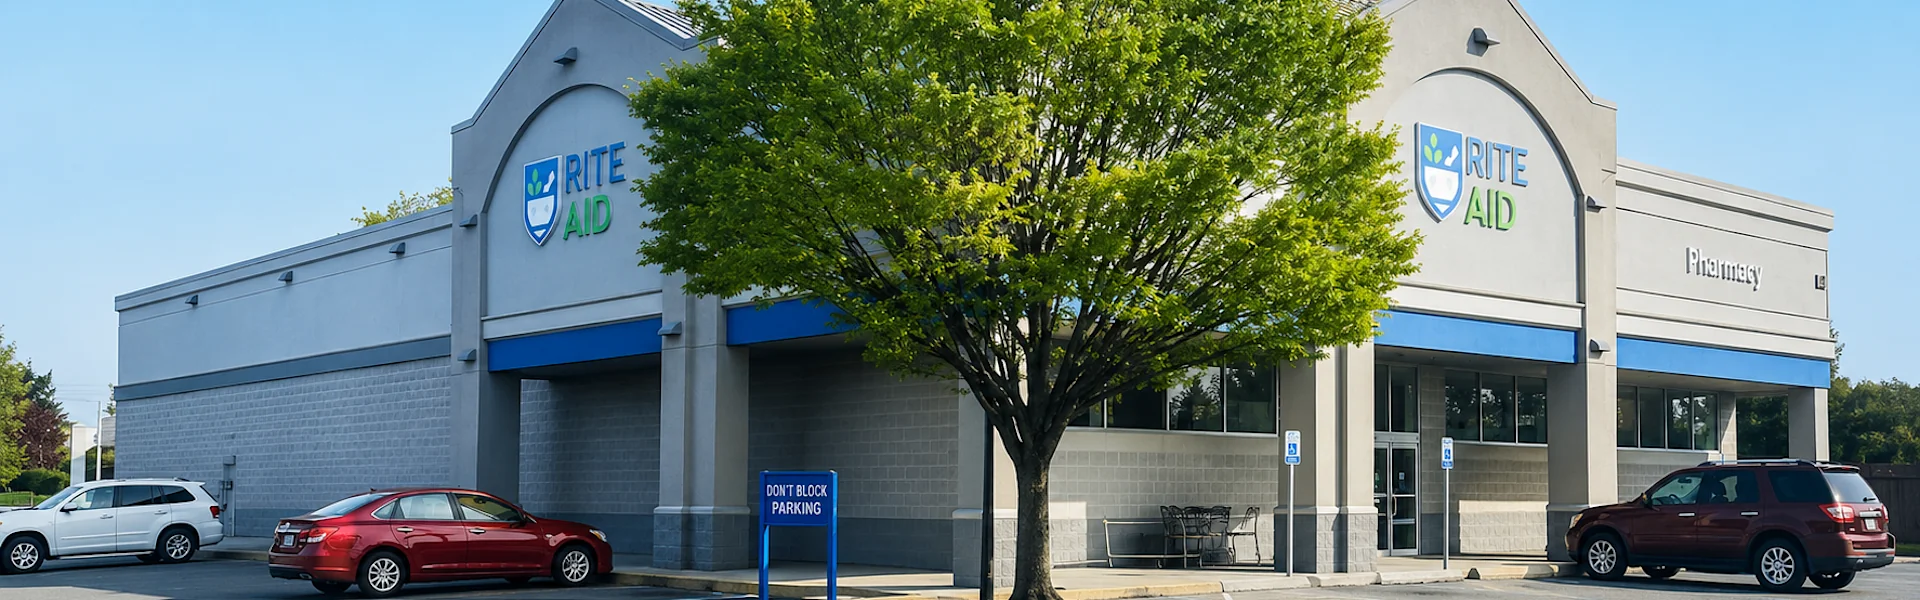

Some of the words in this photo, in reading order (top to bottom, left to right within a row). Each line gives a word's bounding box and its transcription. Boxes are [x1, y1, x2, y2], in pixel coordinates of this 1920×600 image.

[565, 141, 626, 194] RITE
[1465, 136, 1529, 188] RITE
[563, 194, 612, 241] AID
[1463, 186, 1517, 232] AID
[1685, 247, 1763, 291] Pharmacy
[766, 484, 795, 497] DON'T
[796, 484, 828, 497] BLOCK
[772, 501, 822, 515] PARKING
